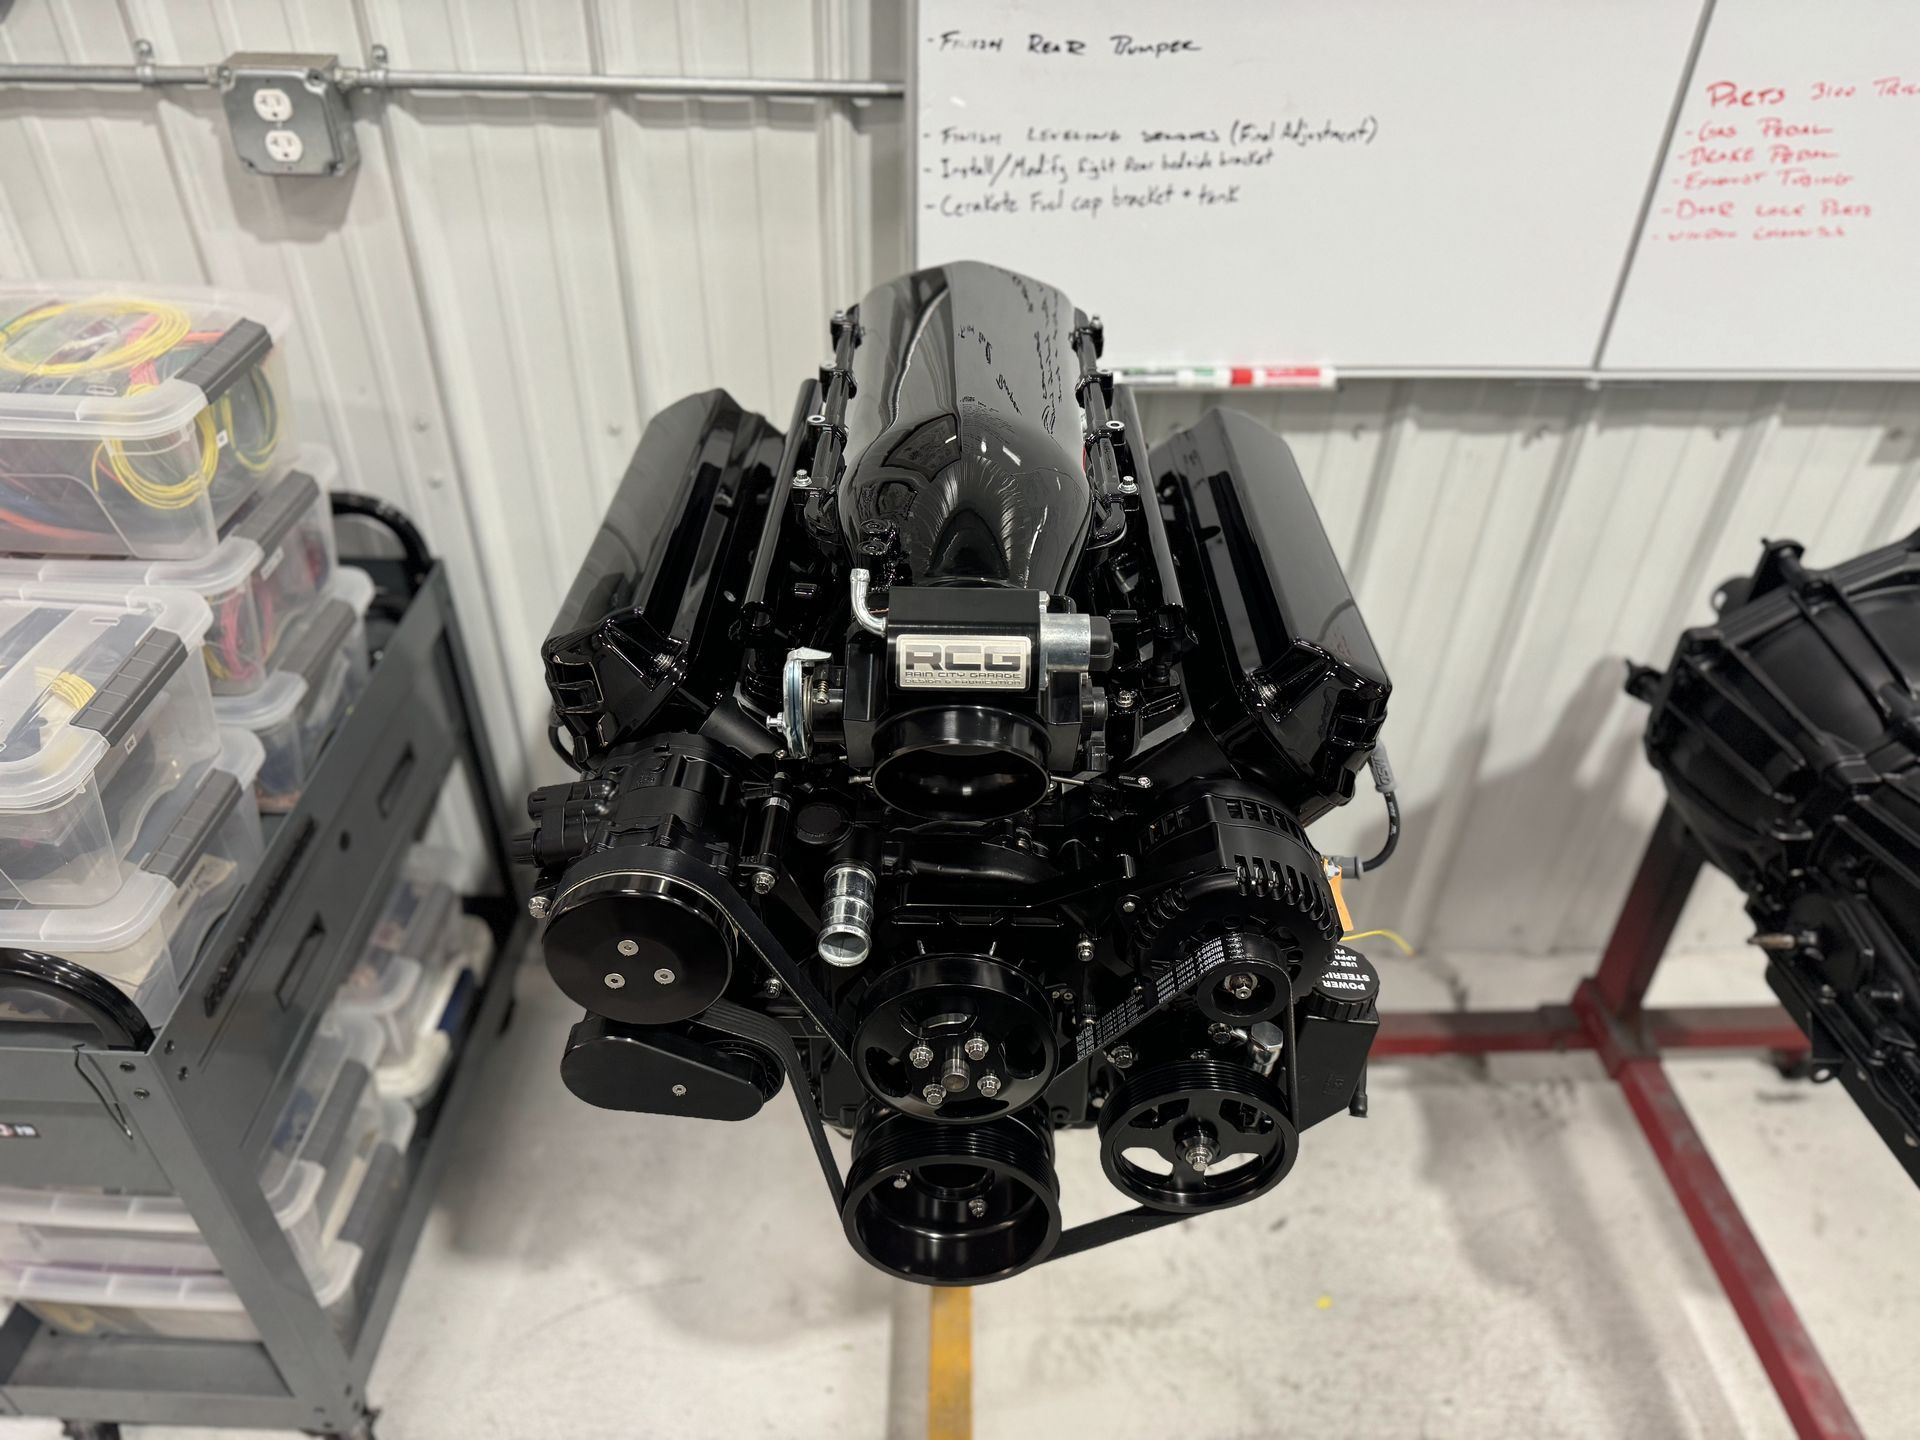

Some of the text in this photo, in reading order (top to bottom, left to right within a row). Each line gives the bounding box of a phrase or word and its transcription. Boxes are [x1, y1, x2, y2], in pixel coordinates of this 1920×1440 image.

[1071, 195, 1104, 219] cap
[906, 645, 1021, 672] RCG
[1322, 980, 1366, 990] POWER
